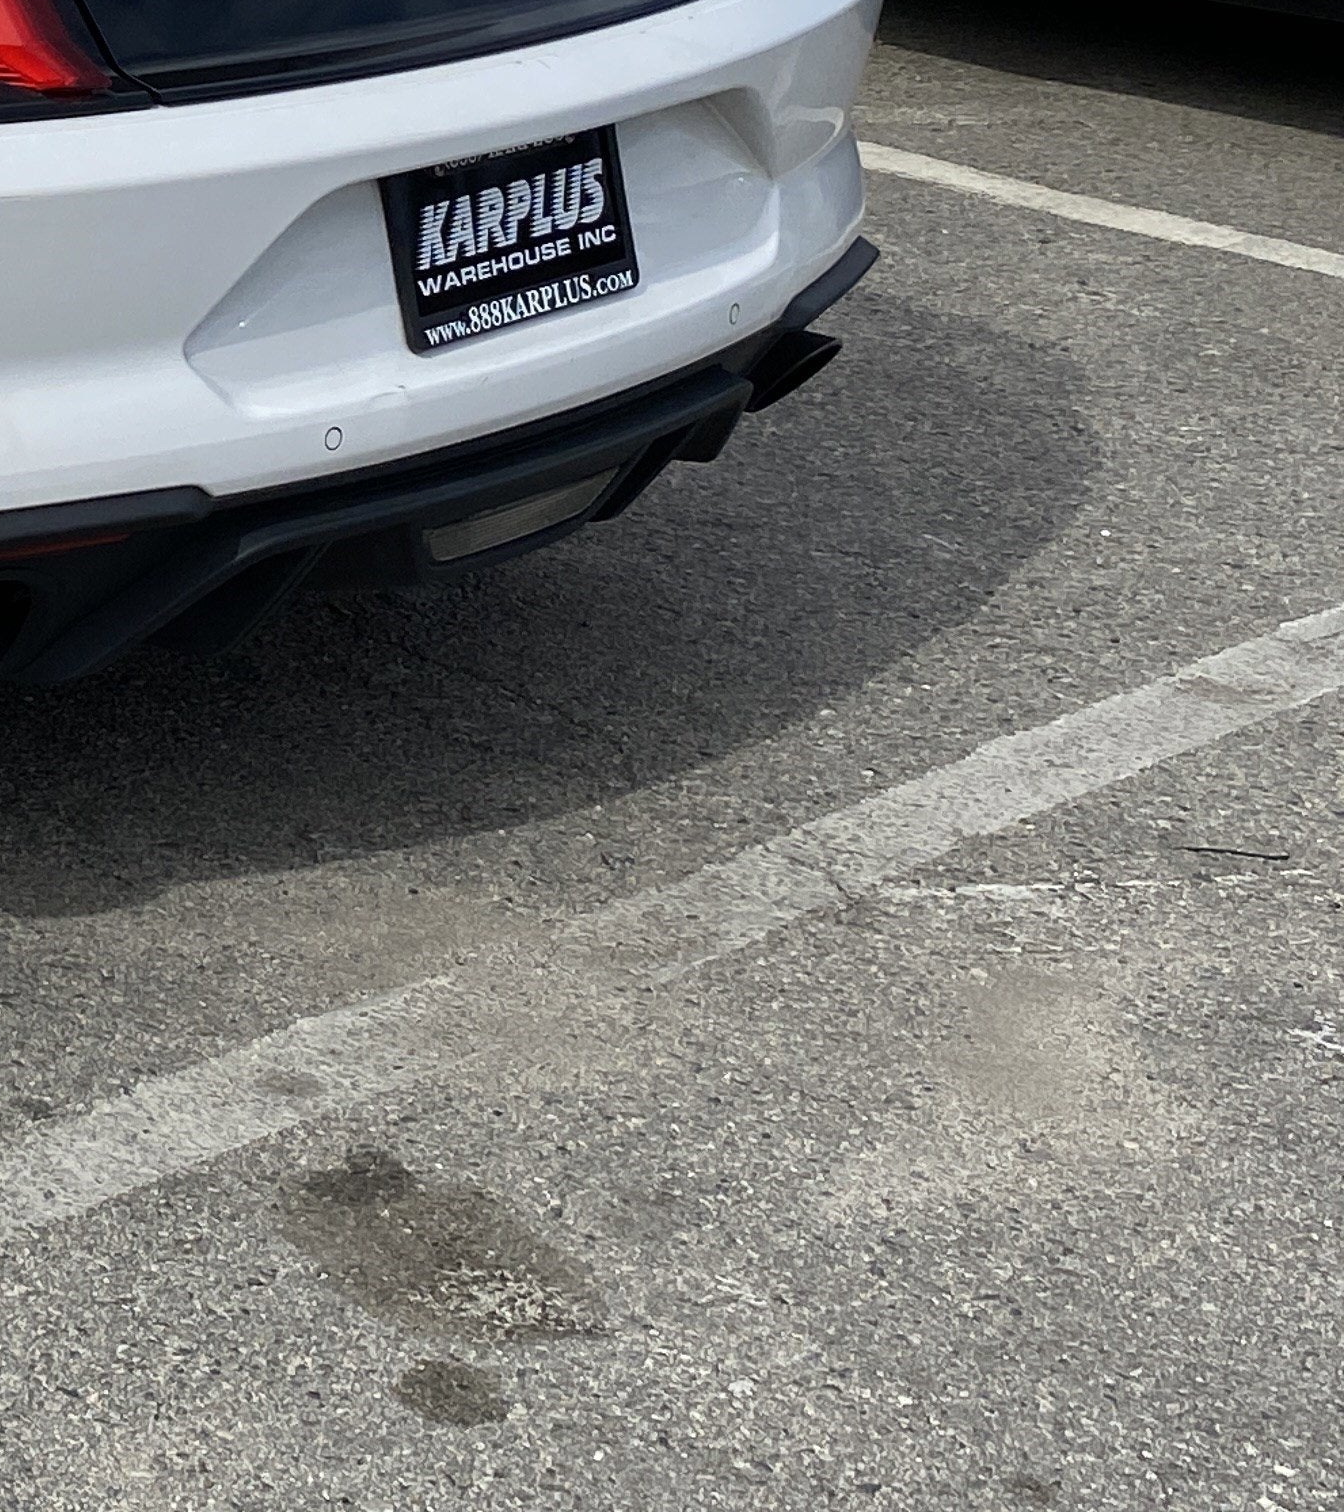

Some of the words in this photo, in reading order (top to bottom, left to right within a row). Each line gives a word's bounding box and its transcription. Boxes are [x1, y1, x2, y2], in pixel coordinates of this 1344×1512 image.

[415, 157, 604, 271] KARPLUS
[417, 238, 571, 297] WAREHOUSE
[577, 224, 616, 251] INC
[424, 270, 634, 346] www.888KARPLUS.COM
